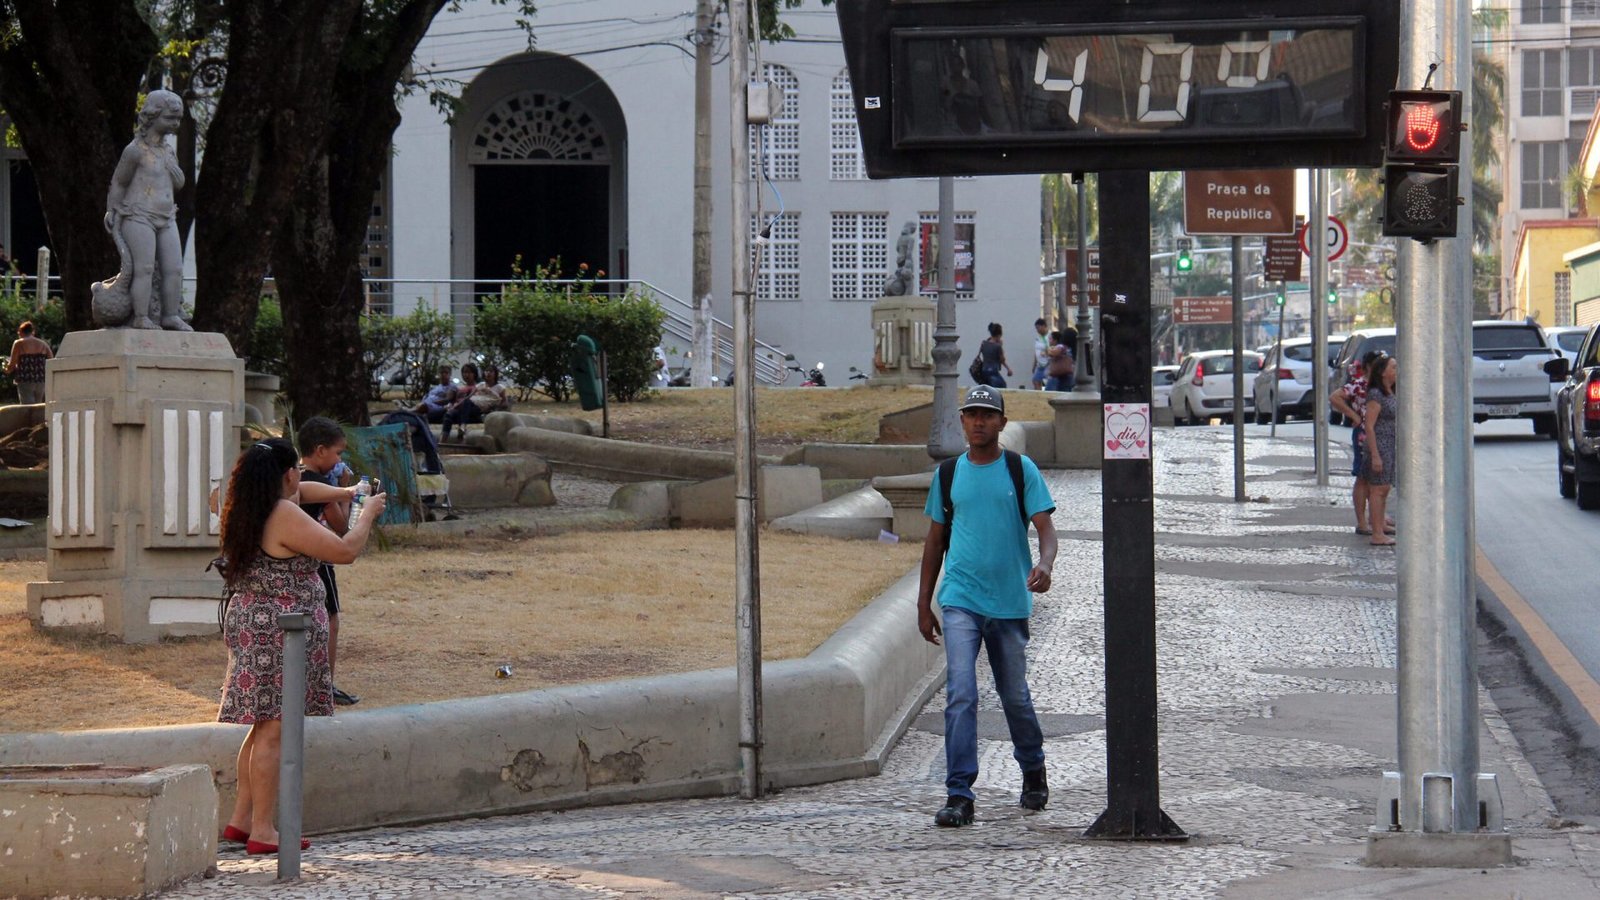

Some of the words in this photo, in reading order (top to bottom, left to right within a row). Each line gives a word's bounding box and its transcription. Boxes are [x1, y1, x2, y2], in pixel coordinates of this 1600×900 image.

[1207, 183, 1247, 198] Praça
[1254, 183, 1271, 195] da
[1207, 207, 1272, 222] República
[1117, 426, 1137, 440] dia
